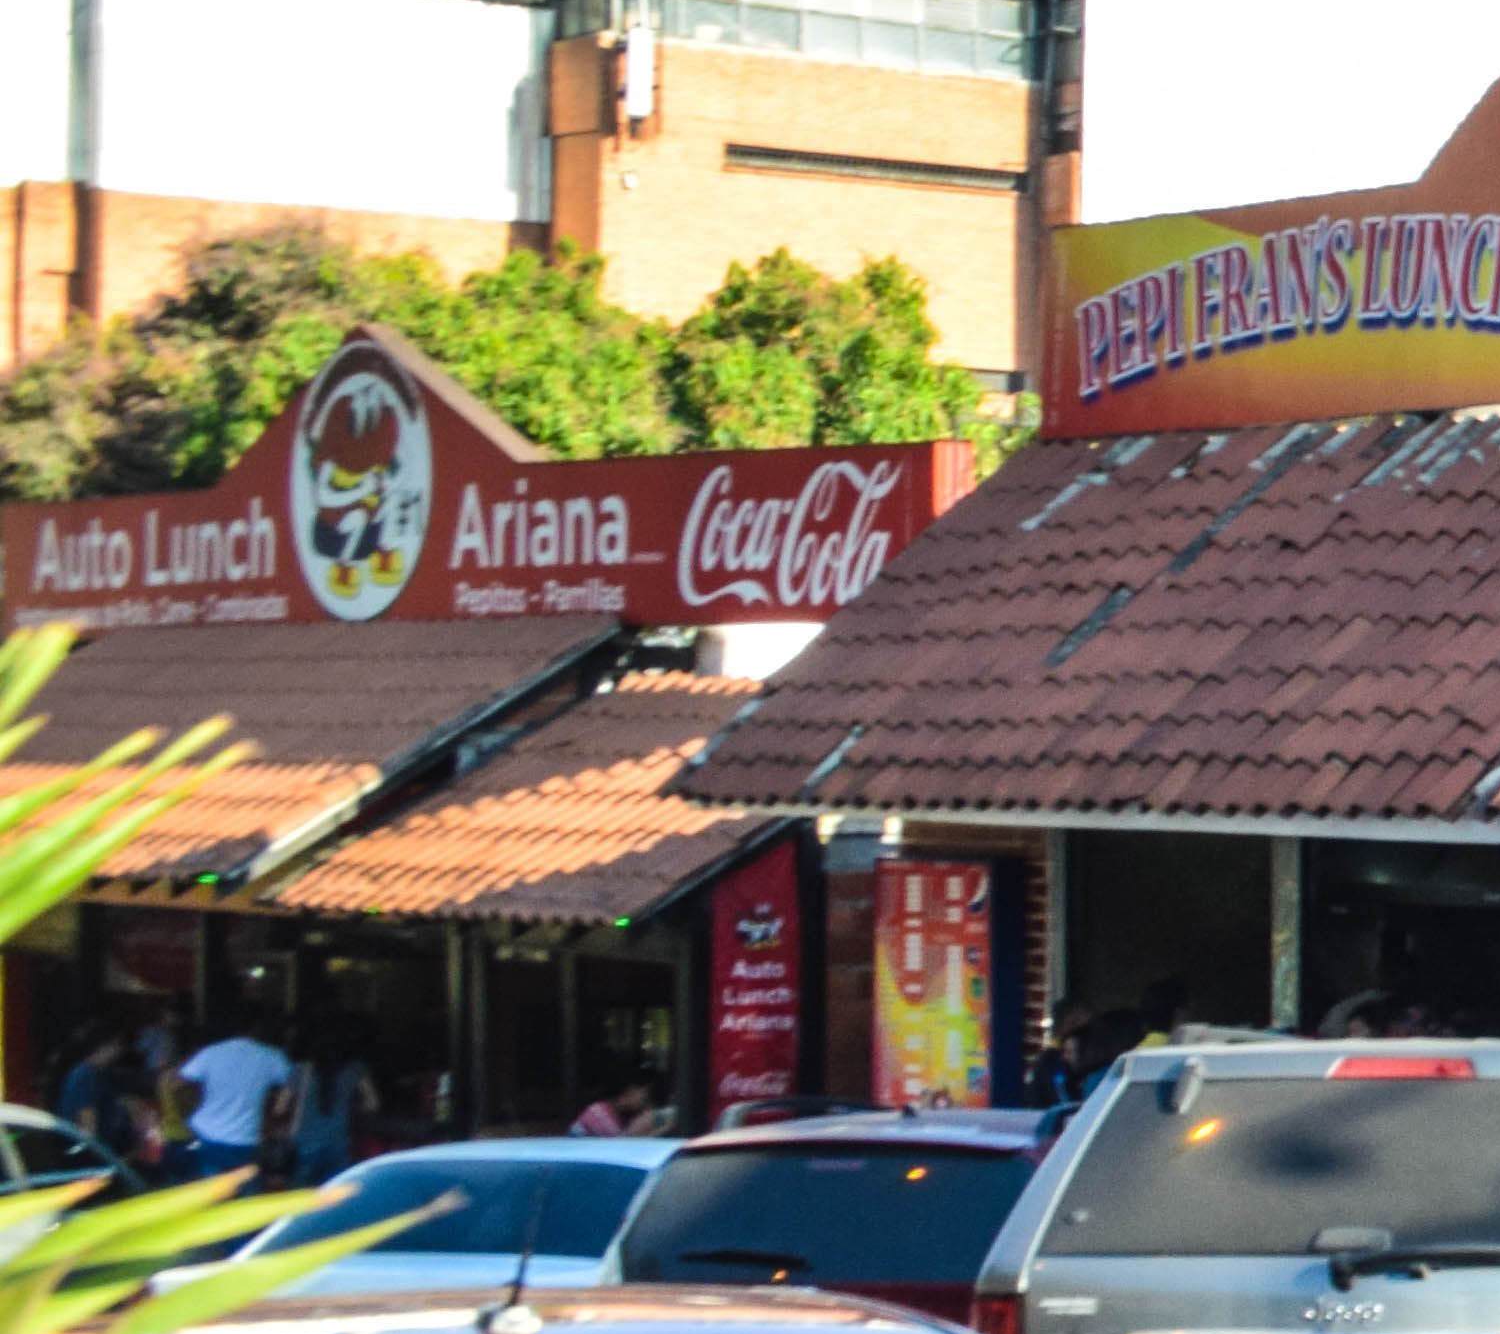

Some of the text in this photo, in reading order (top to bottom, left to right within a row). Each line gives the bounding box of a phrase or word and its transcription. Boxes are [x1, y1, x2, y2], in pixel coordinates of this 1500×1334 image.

[1075, 263, 1187, 401] PEPI
[31, 496, 277, 593] Auto Lunch
[449, 477, 629, 569] Ariana
